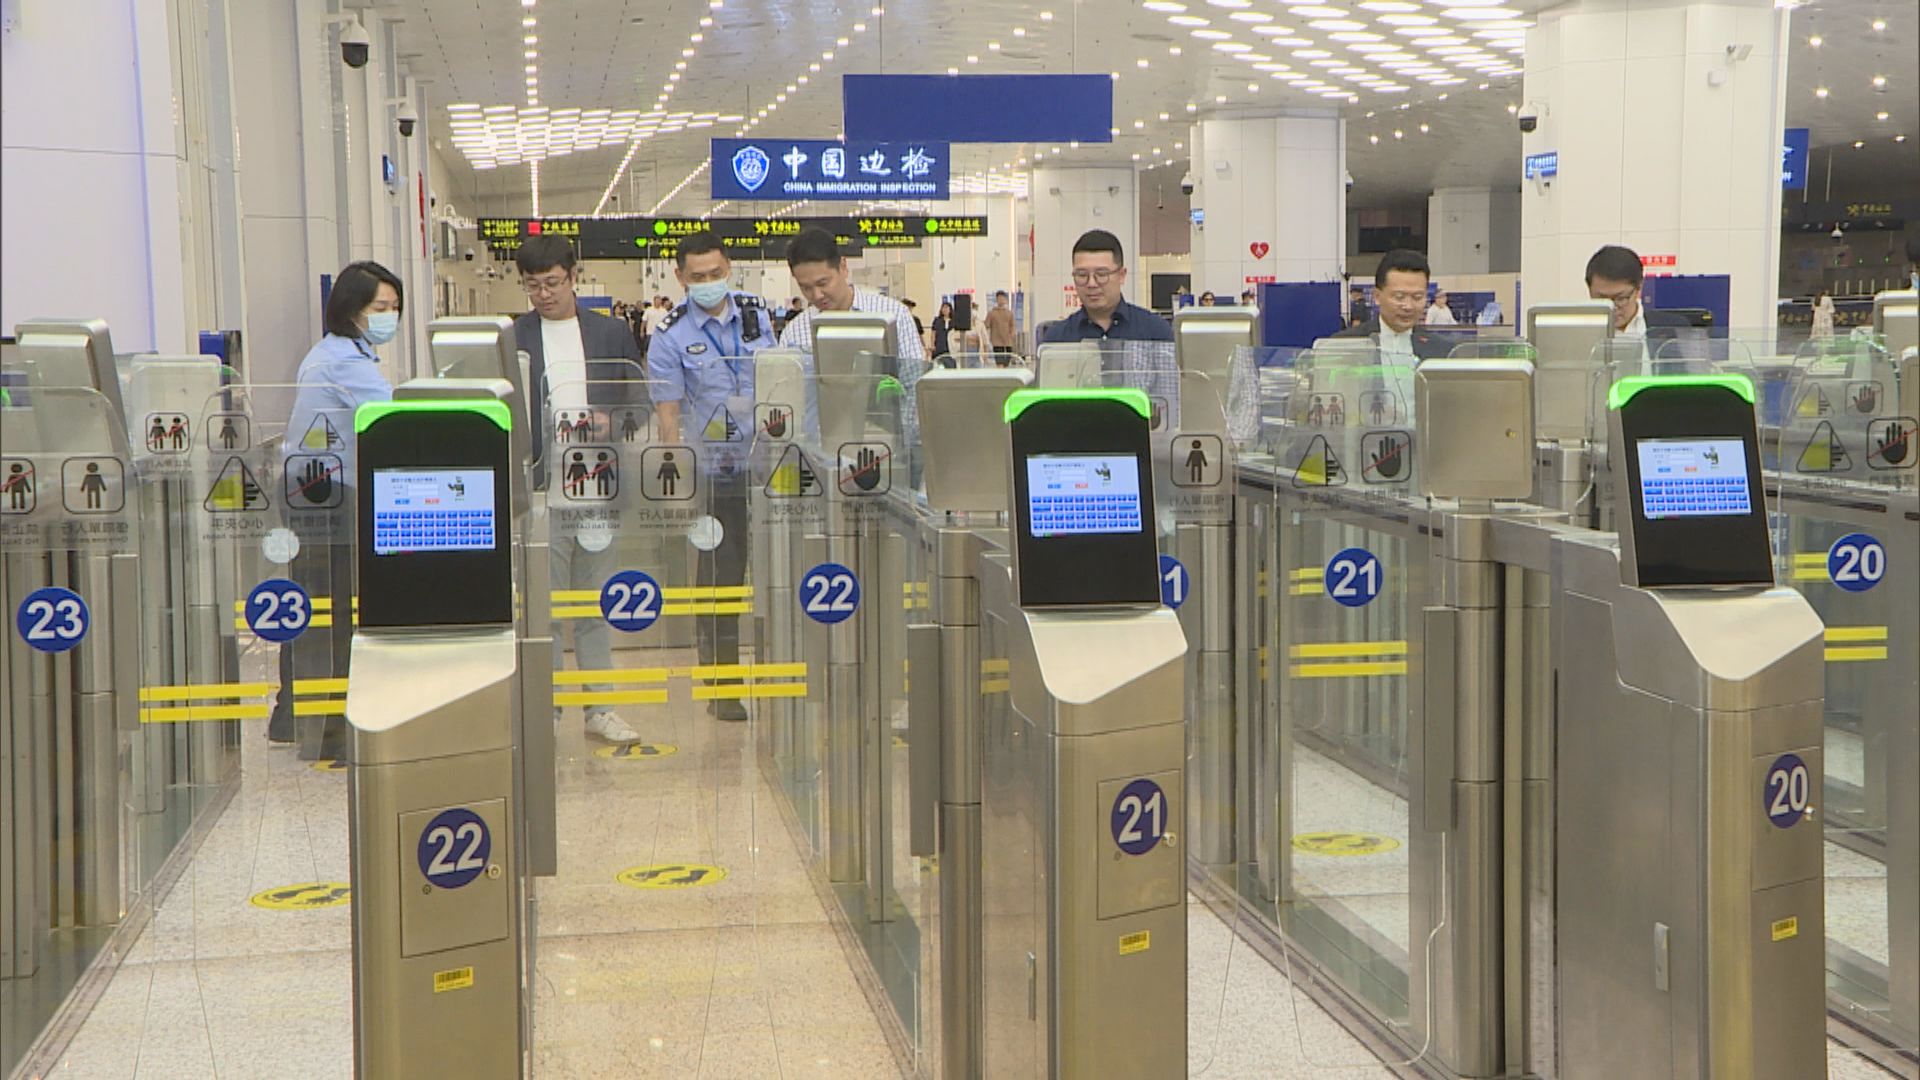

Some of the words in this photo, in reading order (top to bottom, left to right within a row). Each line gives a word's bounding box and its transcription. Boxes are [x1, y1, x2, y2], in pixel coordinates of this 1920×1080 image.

[783, 146, 935, 180] 中国边检
[783, 182, 813, 193] CHINA
[816, 182, 877, 193] IMMIGRATION
[880, 182, 936, 193] INSPECTION
[1333, 560, 1376, 596] 21
[1835, 544, 1884, 581] 20
[607, 582, 656, 619] 22
[807, 574, 854, 611] 22
[1164, 565, 1182, 602] 1
[27, 599, 83, 639] 23
[254, 591, 306, 629] 23
[1769, 765, 1809, 816] 20
[1118, 791, 1161, 844] 21
[426, 821, 484, 876] 22
